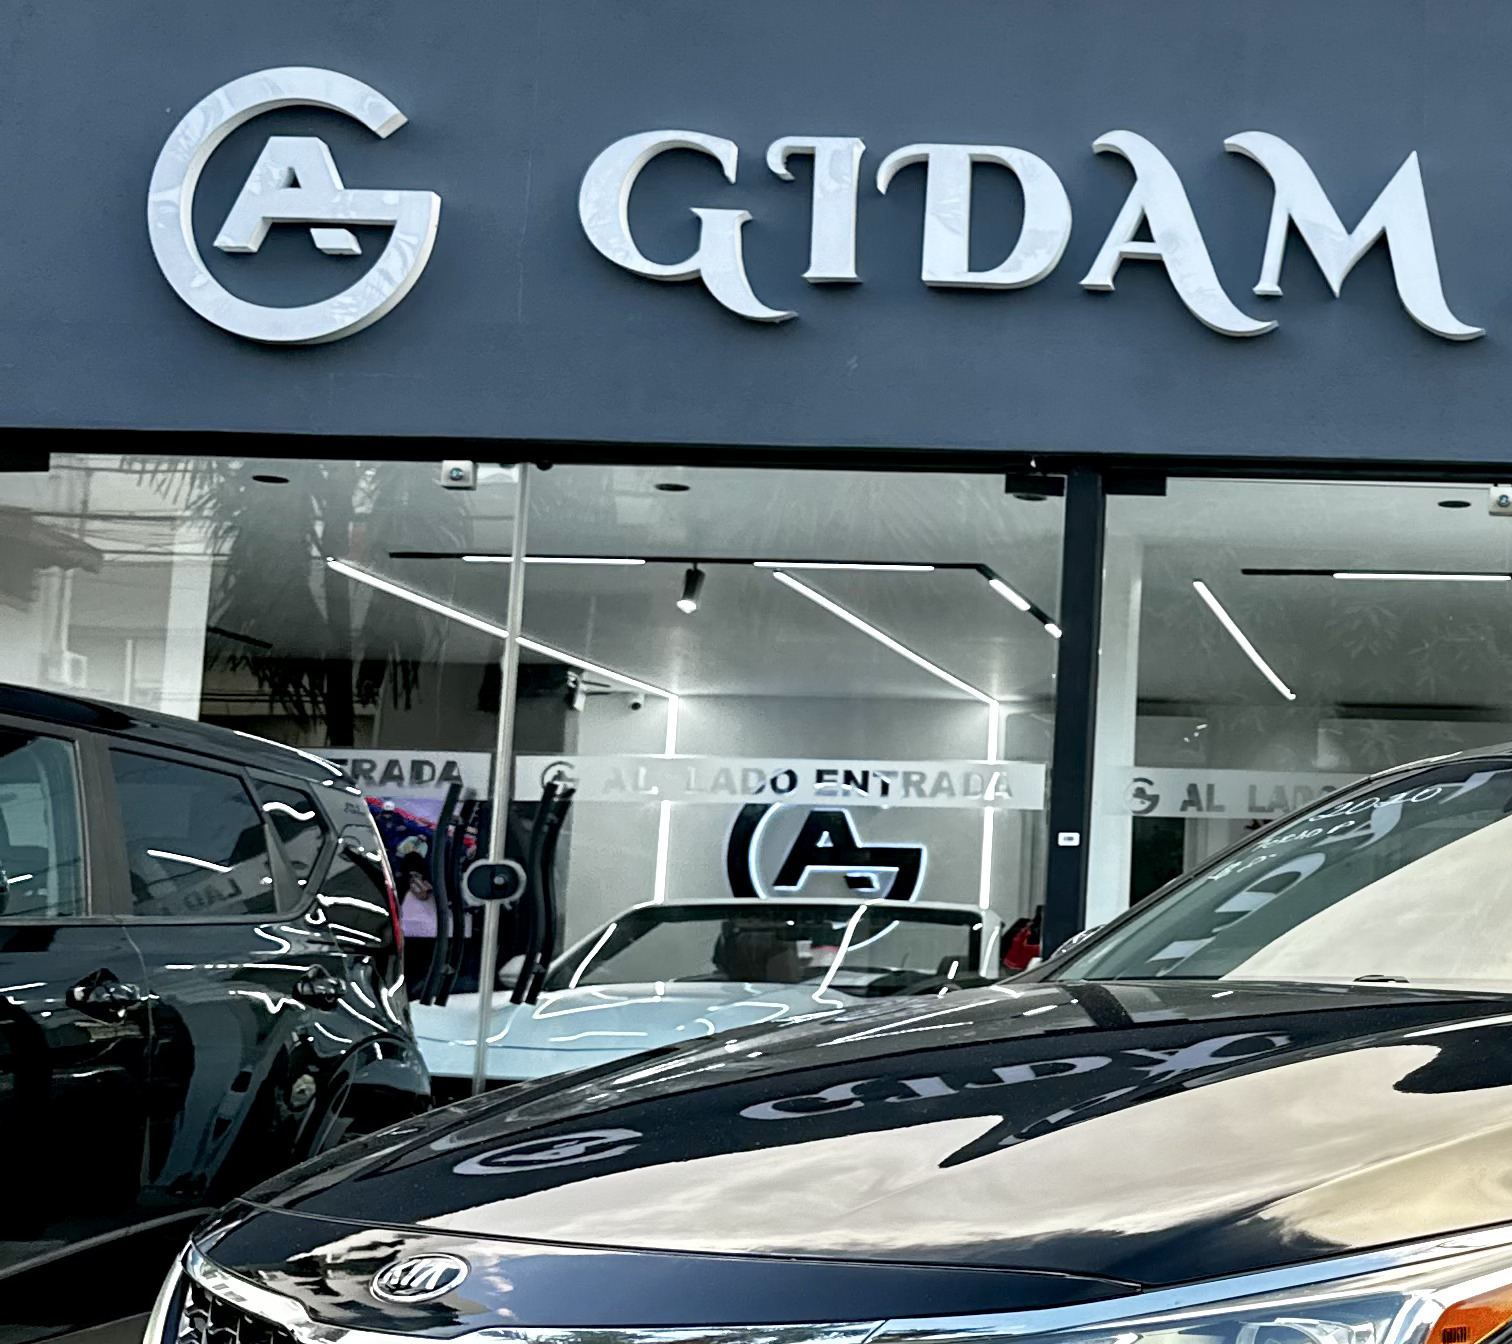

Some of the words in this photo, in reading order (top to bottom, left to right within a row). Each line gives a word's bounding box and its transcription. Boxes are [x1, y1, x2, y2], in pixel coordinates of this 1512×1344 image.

[578, 129, 1486, 341] GIDAM
[327, 758, 463, 788] RADA
[603, 766, 659, 795] AL
[684, 766, 798, 796] LADO
[813, 768, 1014, 799] ENTRADA
[1179, 783, 1226, 813] AL
